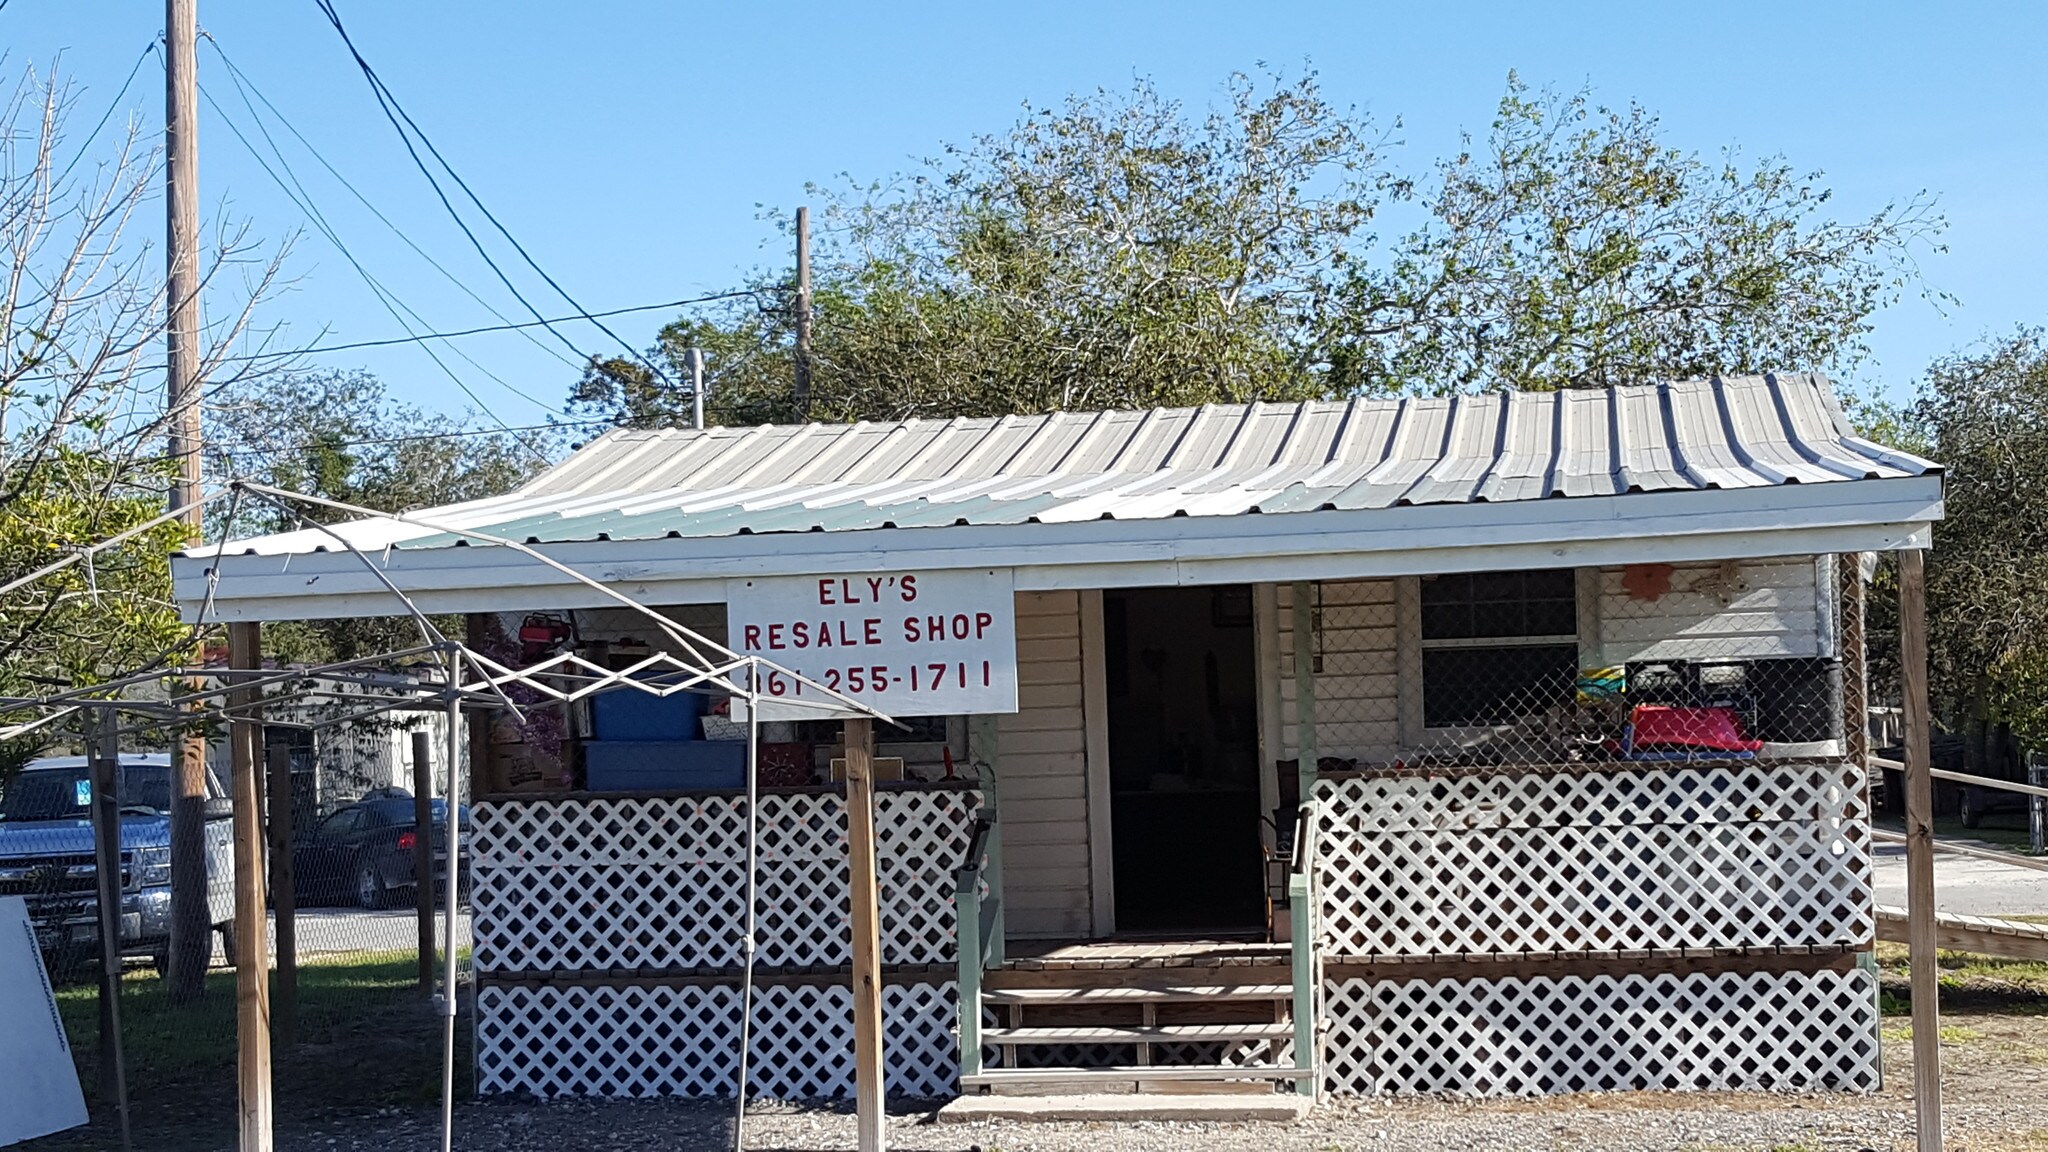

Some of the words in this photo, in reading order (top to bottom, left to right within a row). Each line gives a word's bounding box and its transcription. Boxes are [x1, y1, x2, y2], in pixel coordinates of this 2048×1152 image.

[819, 575, 917, 605] ELY'S
[744, 618, 882, 650] RESALE
[904, 612, 992, 643] SHOP
[745, 660, 990, 696] 61255-1711
